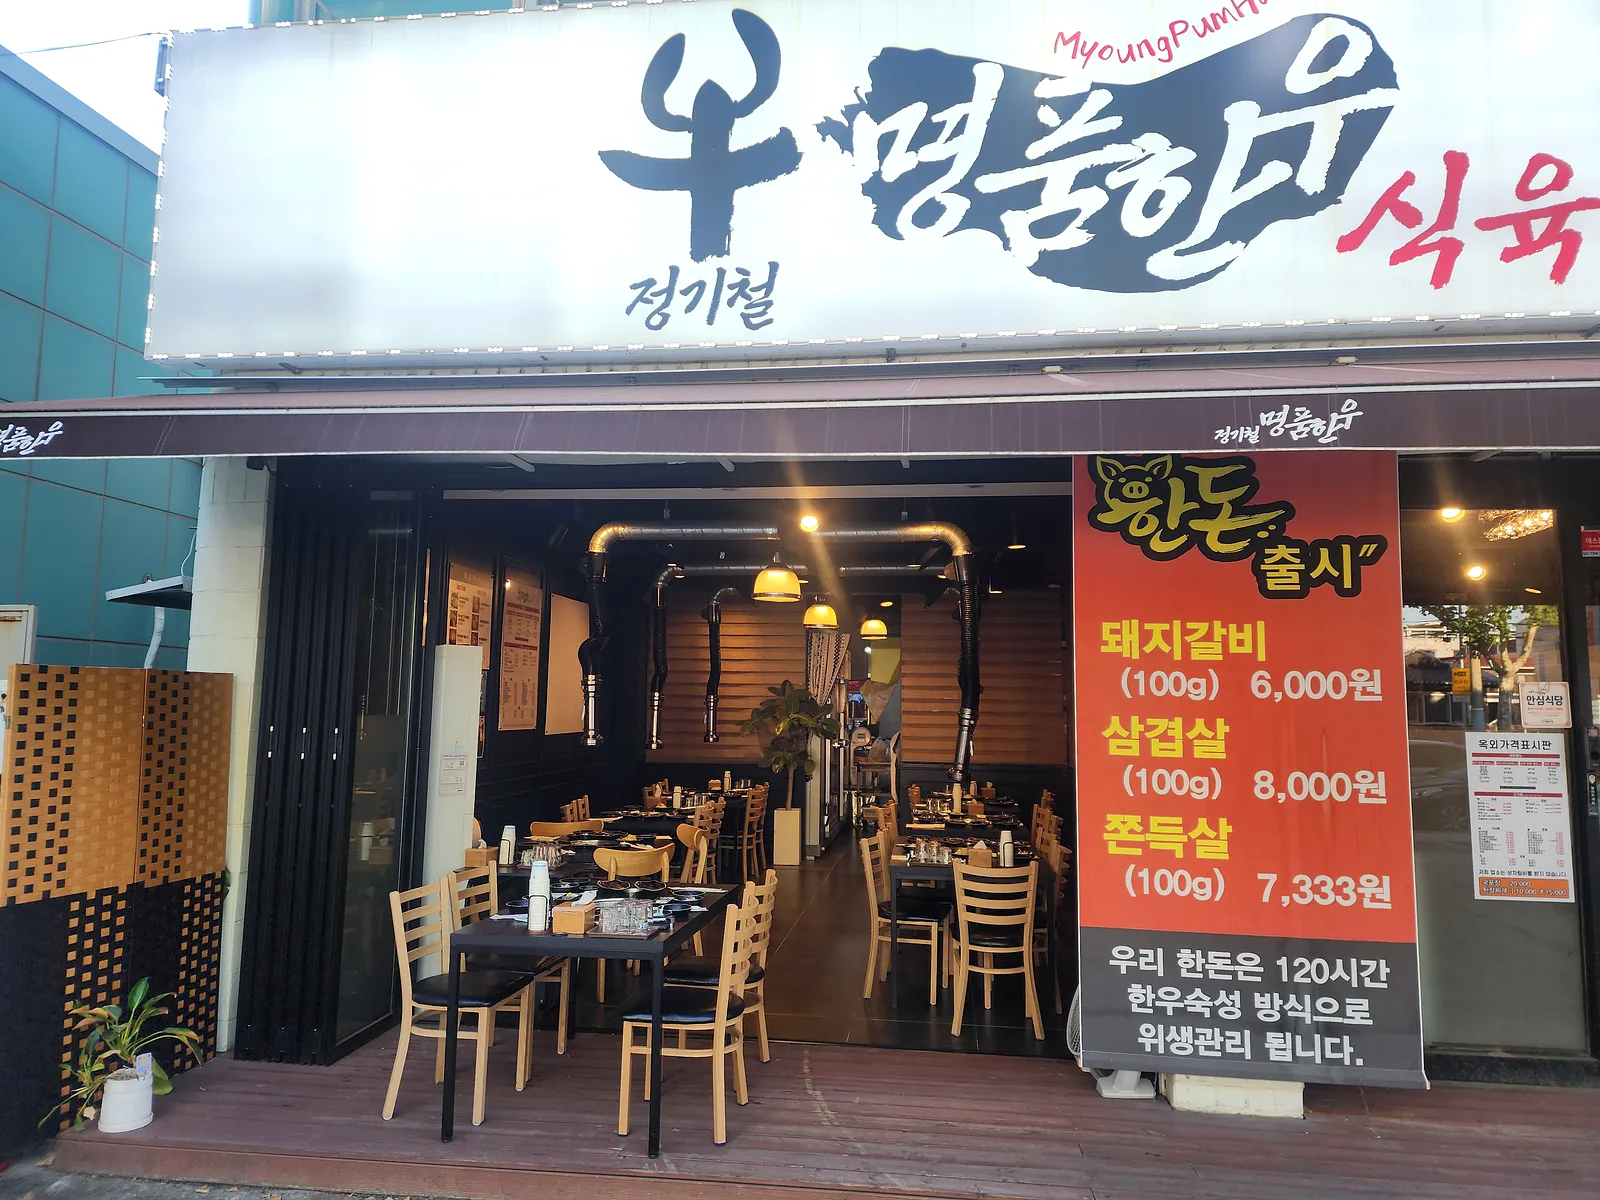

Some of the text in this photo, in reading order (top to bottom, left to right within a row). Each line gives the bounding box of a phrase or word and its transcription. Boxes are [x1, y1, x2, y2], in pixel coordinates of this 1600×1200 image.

[850, 16, 1401, 283] 명품한우
[1336, 149, 1600, 290] 식육
[625, 261, 780, 331] 정기철
[1214, 398, 1364, 444] 정기철 명품한우
[1101, 619, 1267, 662] 돼지갈비
[1120, 666, 1384, 703] (100g) 6,000원
[1526, 695, 1564, 706] 안심식당
[1101, 715, 1231, 760] 삼겹살
[1122, 764, 1388, 805] (100g) 8,000원
[1103, 813, 1233, 860] 쫀득살
[1124, 863, 1393, 910] (100g) 7,333원
[1108, 944, 1391, 989] 우리 한돈은 120시간
[1126, 982, 1374, 1026] 한우숙성 방식으로
[1136, 1022, 1364, 1067] 위생관리 됩니다.
